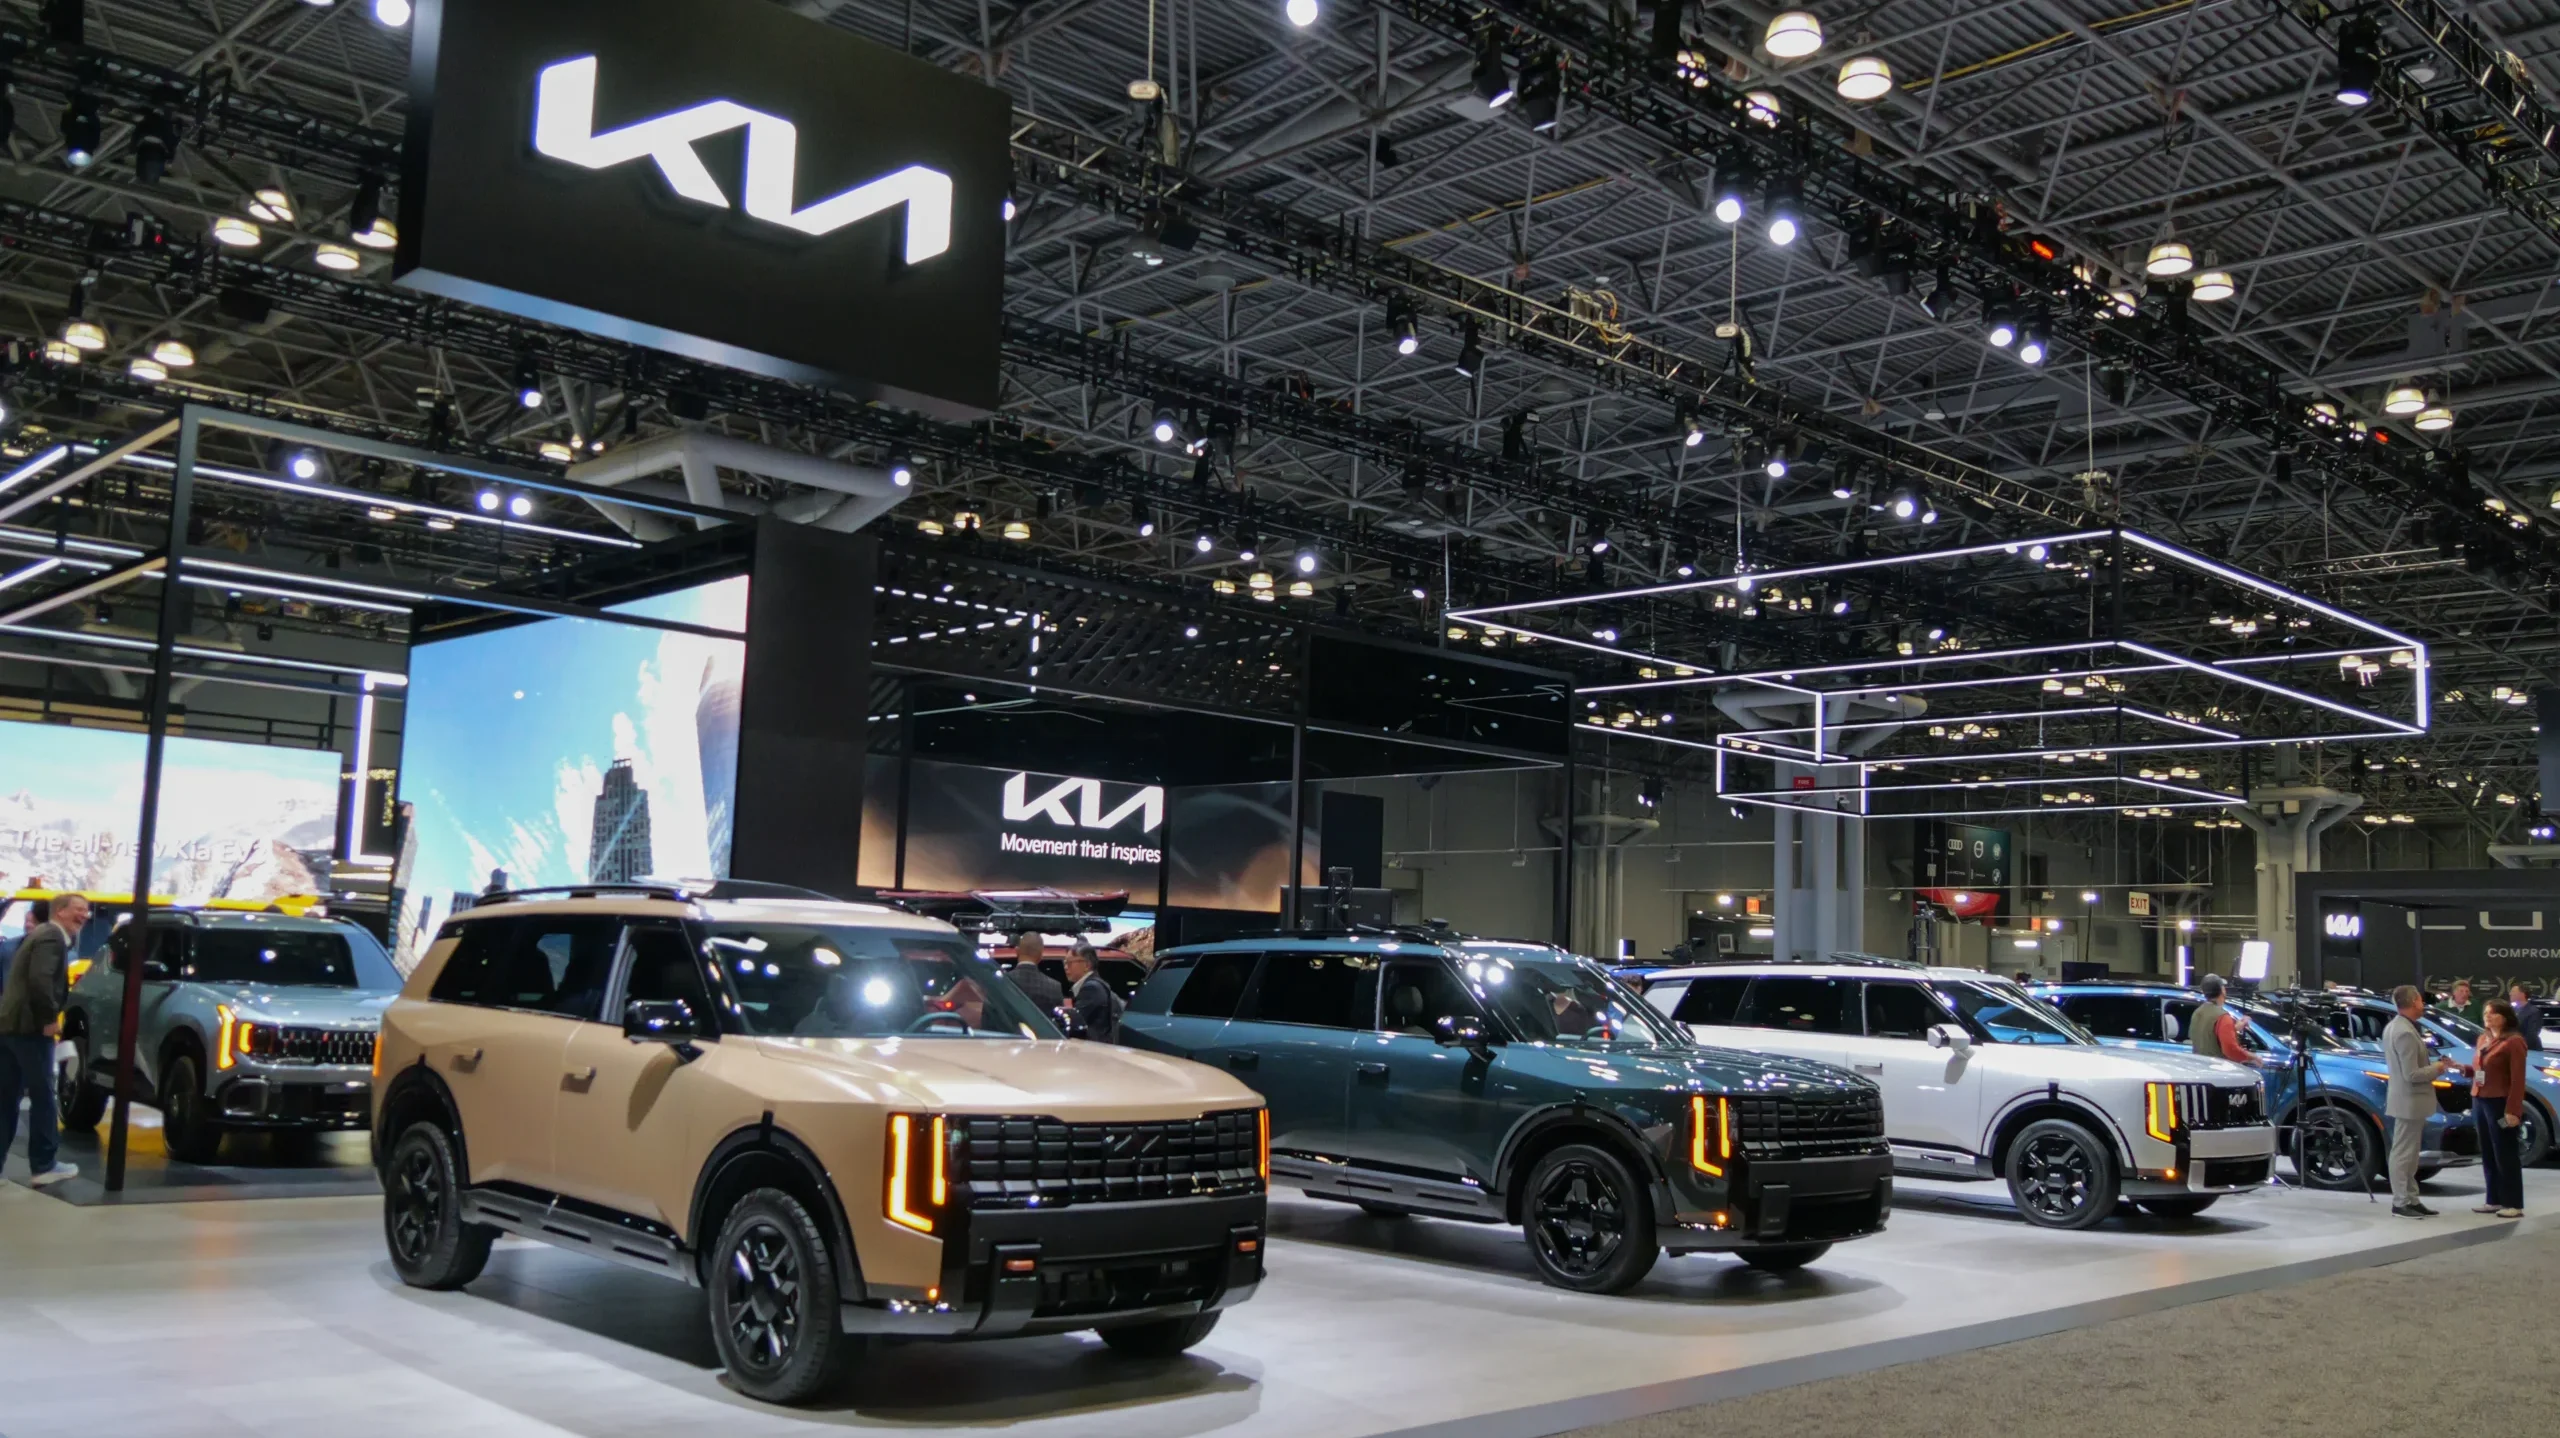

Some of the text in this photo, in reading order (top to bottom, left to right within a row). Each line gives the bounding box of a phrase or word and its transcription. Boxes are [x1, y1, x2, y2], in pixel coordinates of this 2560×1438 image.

[535, 55, 953, 266] KIA
[1003, 771, 1164, 833] KIA
[15, 829, 62, 852] The
[173, 837, 213, 861] Kia
[1001, 832, 1162, 865] Movement that inspires
[2130, 897, 2148, 910] EXIT
[2487, 947, 2560, 958] COMPROM
